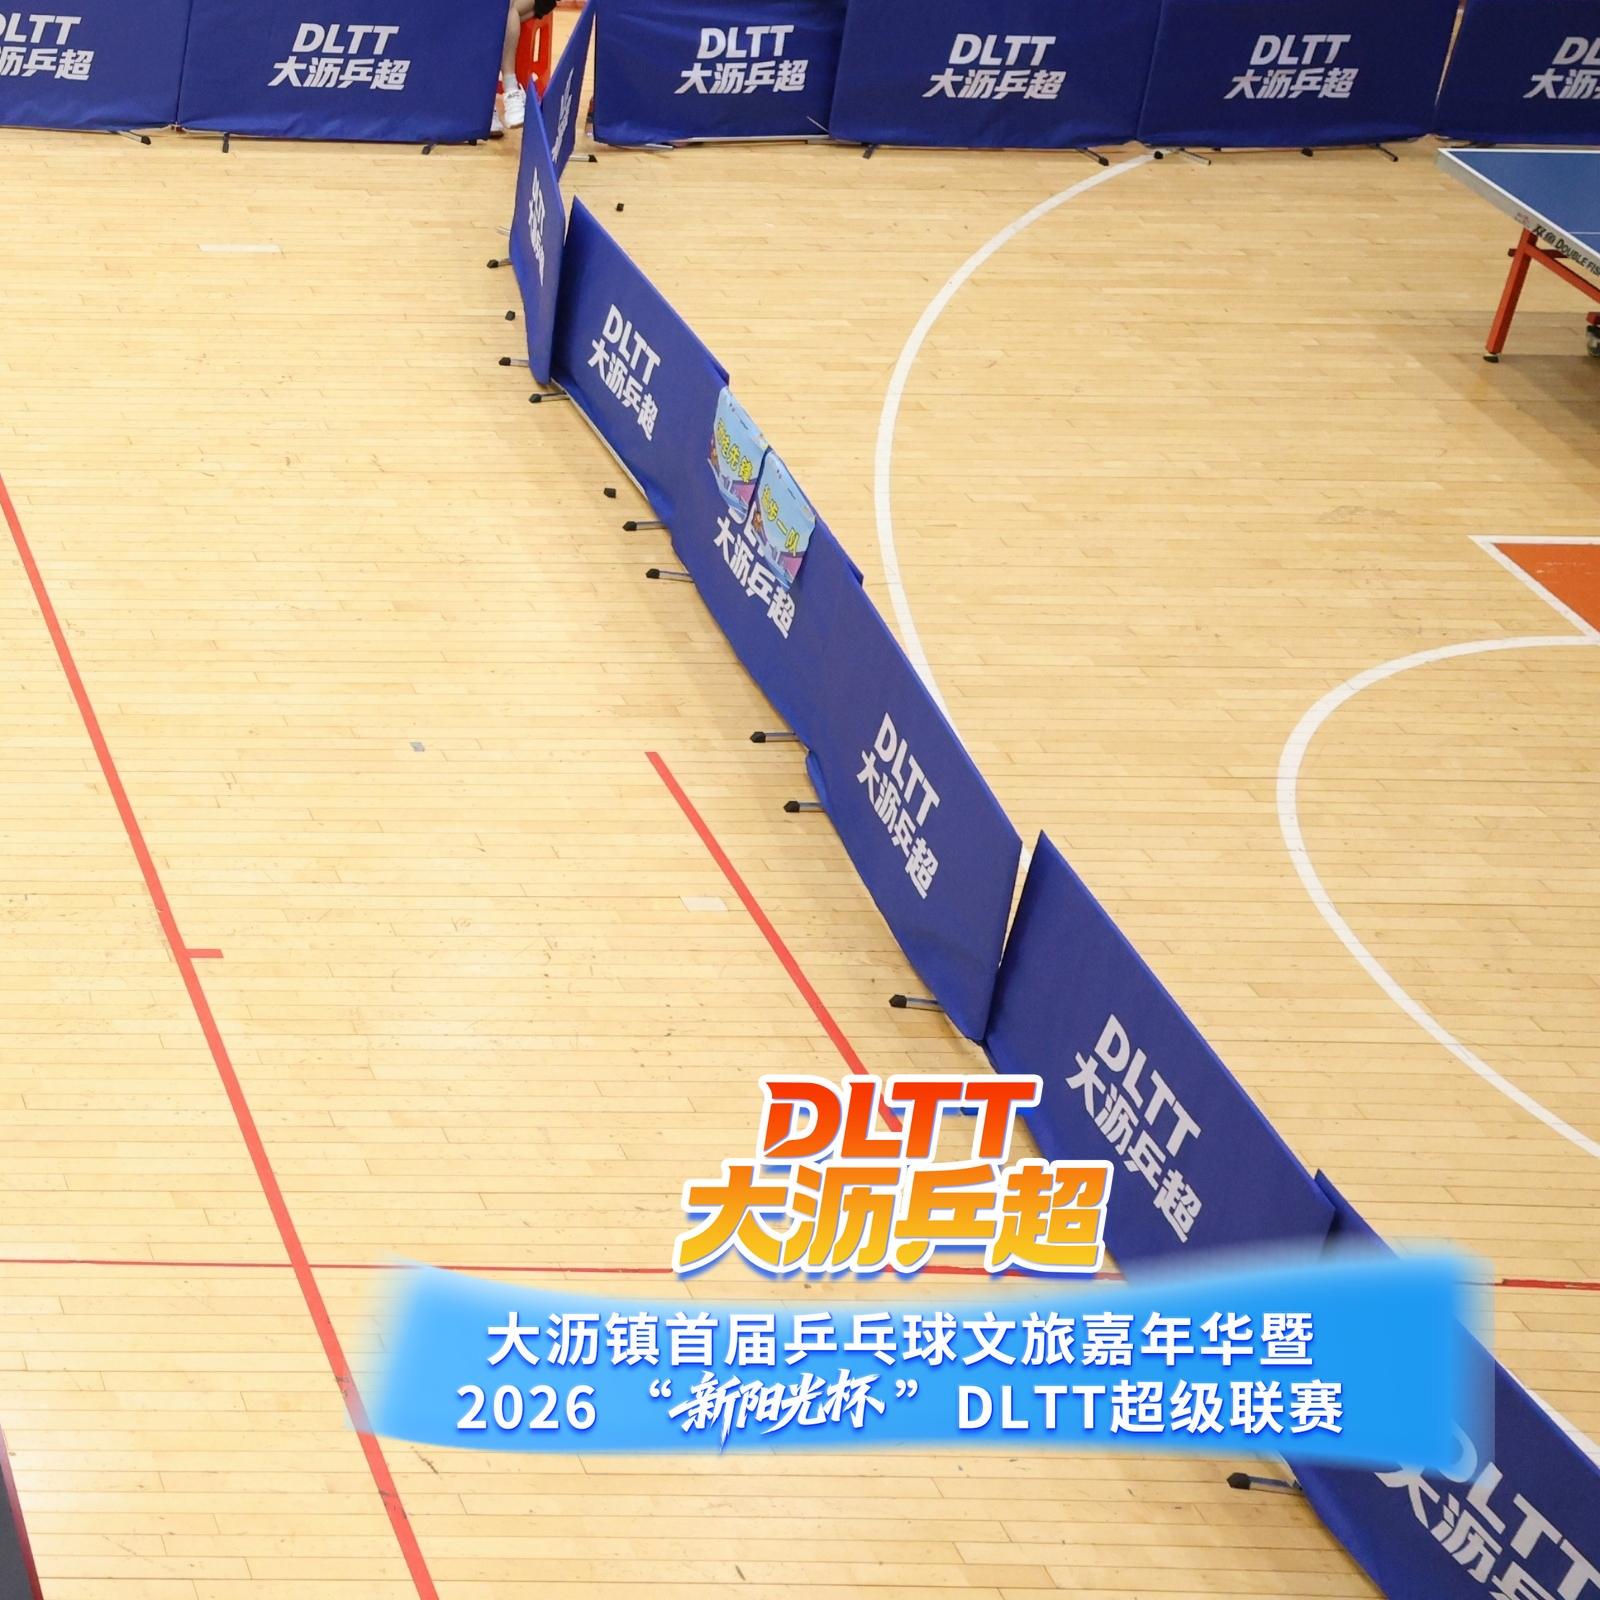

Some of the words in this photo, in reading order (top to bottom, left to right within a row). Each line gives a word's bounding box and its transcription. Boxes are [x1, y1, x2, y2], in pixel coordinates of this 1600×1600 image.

[292, 23, 399, 54] DLTT
[697, 25, 794, 58] DLTT
[949, 34, 1056, 65] DLTT
[1250, 35, 1351, 65] DLTT
[268, 56, 410, 90] 大沥乒超
[675, 60, 808, 93] 大沥乒超
[923, 68, 1066, 99] 大沥乒超
[1224, 68, 1358, 99] 大沥乒超
[1531, 223, 1557, 245] 双鱼
[1556, 237, 1591, 266] DOUBLE
[603, 304, 660, 385] DLTT
[588, 338, 658, 440] 大沥乒超
[714, 517, 801, 638] 大沥乒超
[874, 713, 940, 826] DLTT
[857, 751, 940, 899] 大沥乒超
[1095, 1015, 1201, 1156] DLTT
[1066, 1048, 1201, 1243] 大沥乒超
